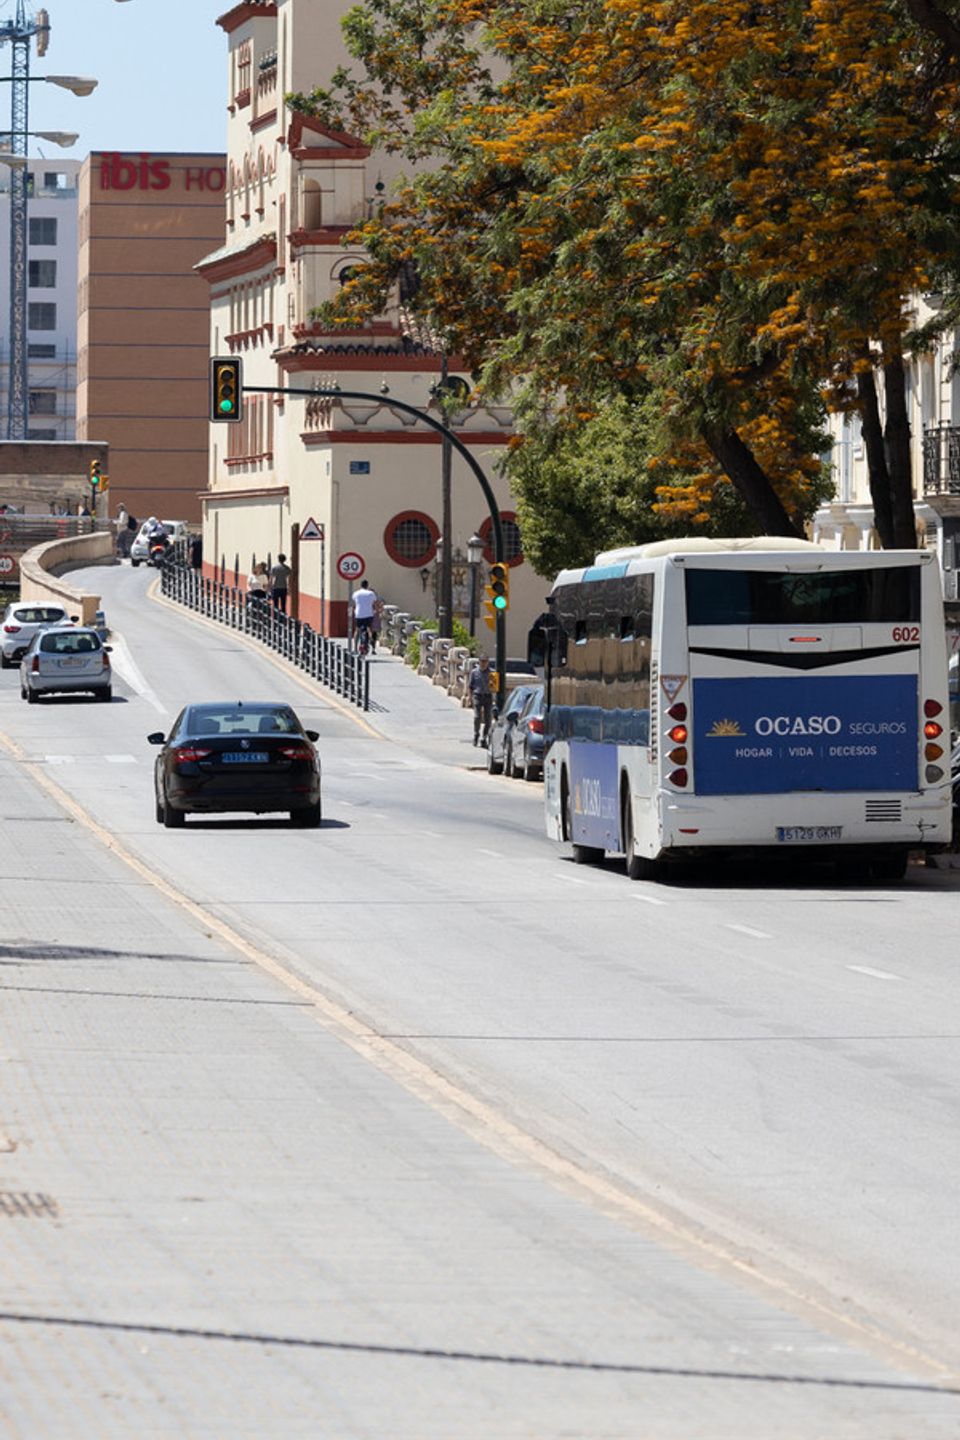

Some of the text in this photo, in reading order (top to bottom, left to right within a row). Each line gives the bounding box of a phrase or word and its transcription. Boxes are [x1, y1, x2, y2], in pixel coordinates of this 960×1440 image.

[101, 151, 226, 191] ibis HO
[342, 561, 359, 571] 30
[892, 627, 920, 642] 602
[755, 716, 907, 736] OCASO SEGUROS
[736, 745, 878, 757] HOGAR VIDA DECESOS
